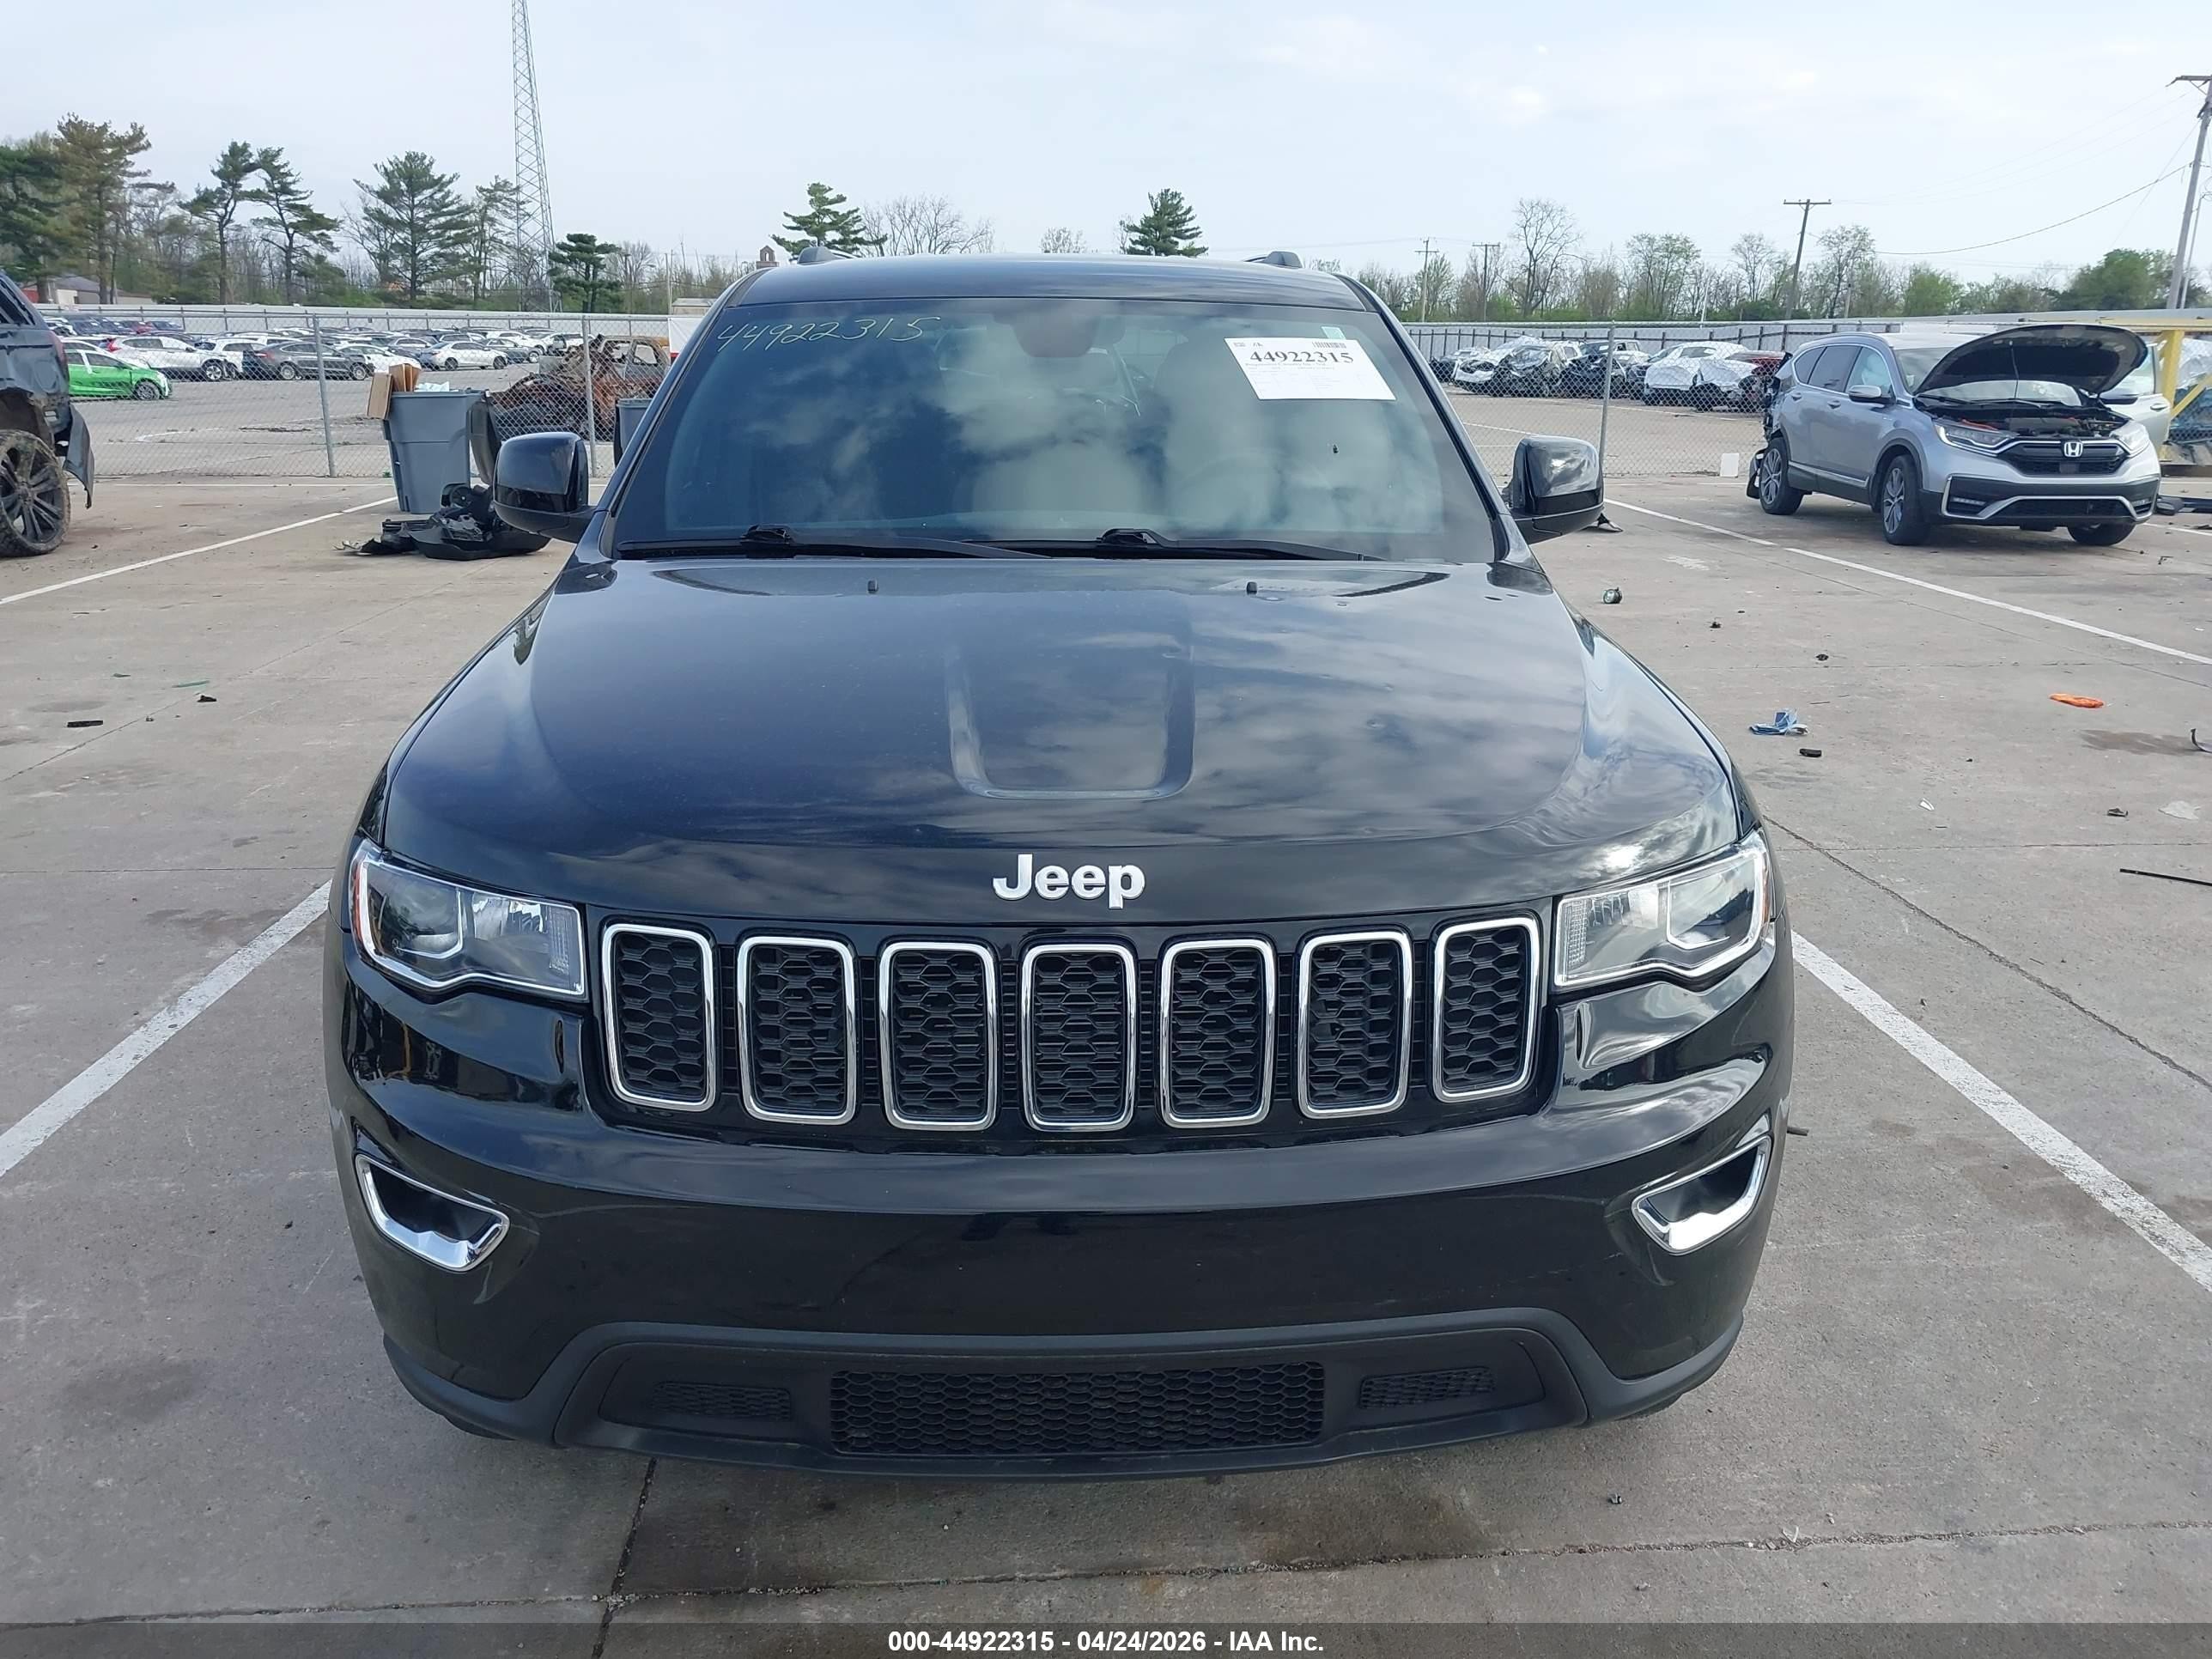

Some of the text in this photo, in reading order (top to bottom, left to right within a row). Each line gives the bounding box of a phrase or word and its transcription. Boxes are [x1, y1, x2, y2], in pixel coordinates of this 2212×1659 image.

[717, 317, 940, 352] 44922315
[1249, 350, 1354, 363] 44922315
[993, 854, 1146, 908] Jeep
